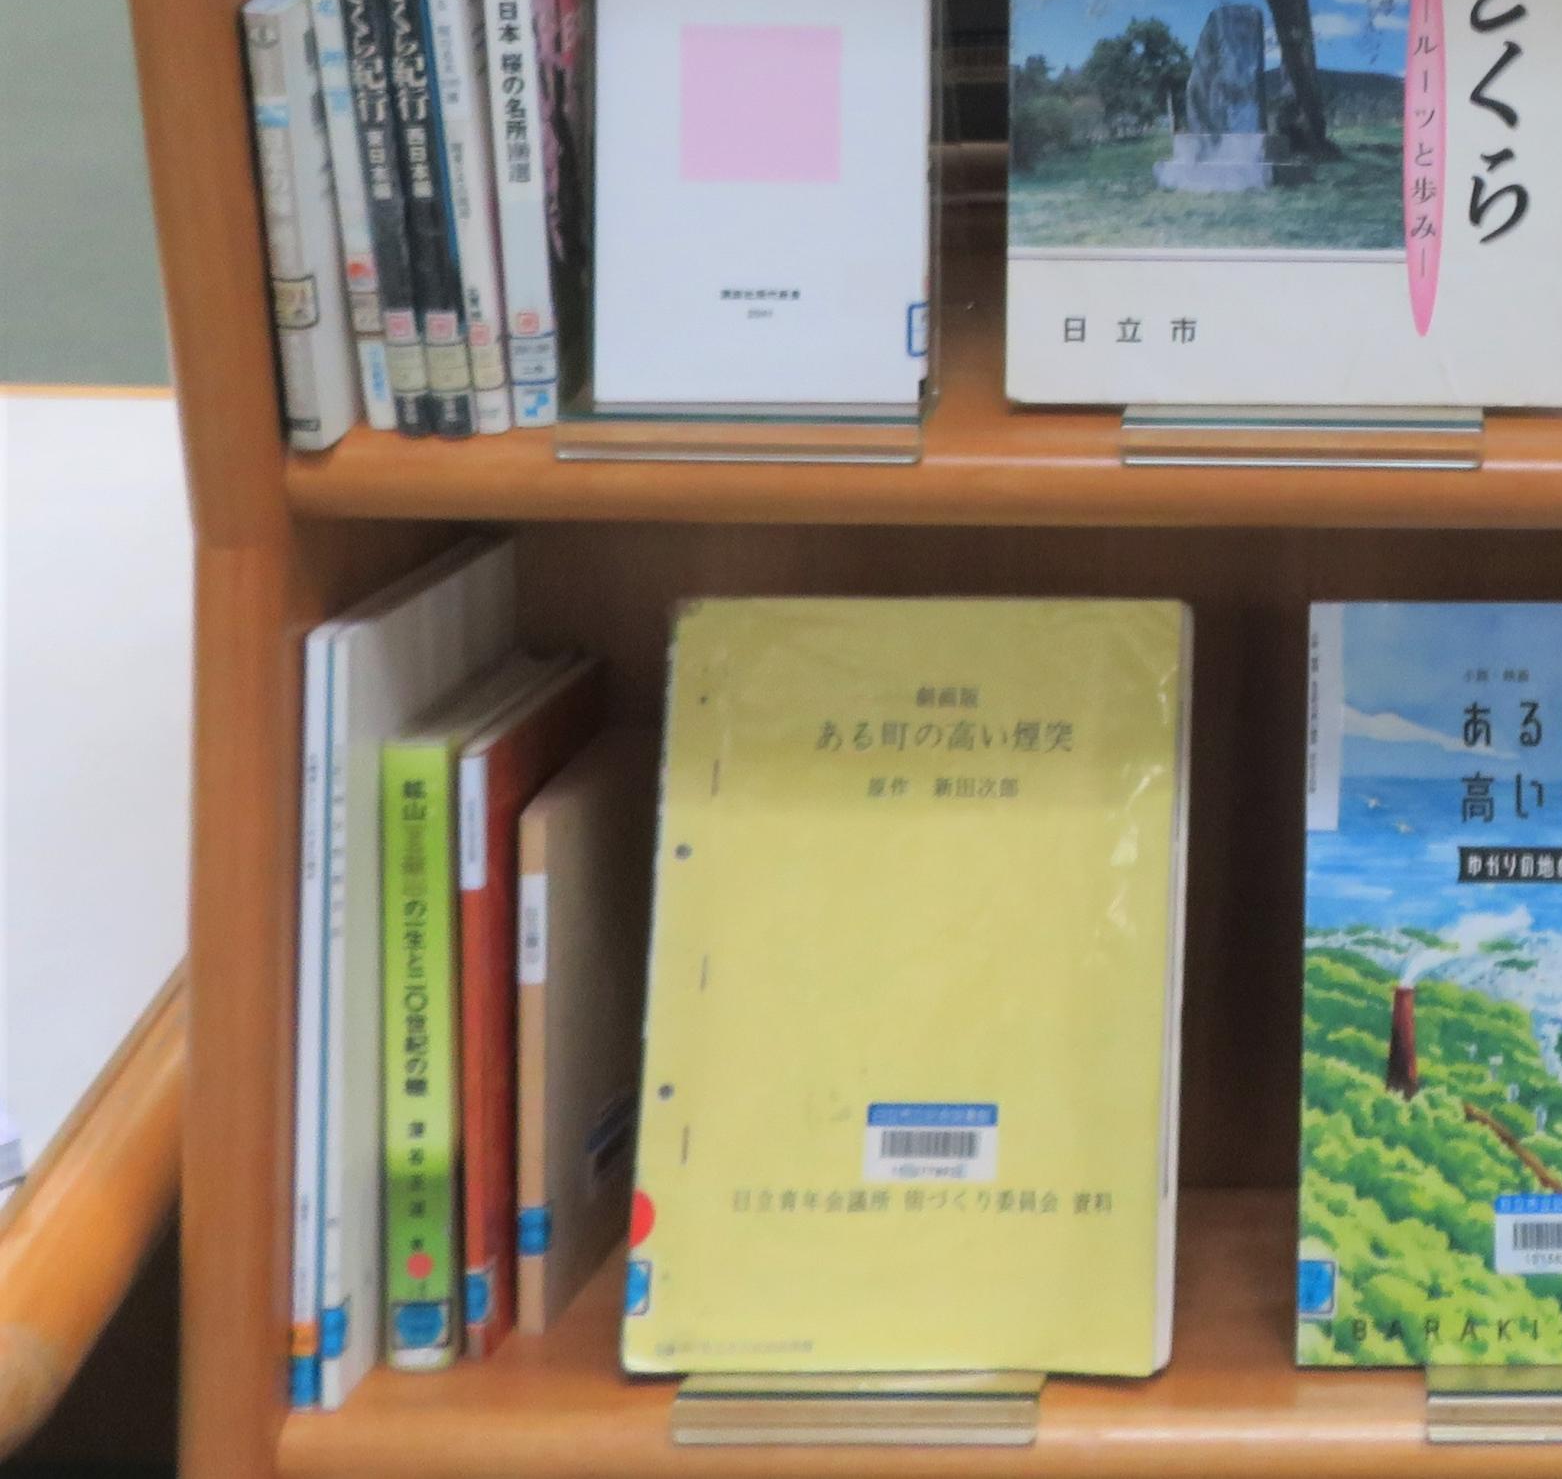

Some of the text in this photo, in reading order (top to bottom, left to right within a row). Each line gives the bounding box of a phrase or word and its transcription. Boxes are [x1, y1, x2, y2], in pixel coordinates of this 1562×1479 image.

[1062, 316, 1198, 345] 日立市
[814, 719, 1075, 754] ある町の高い煙突
[932, 775, 1020, 800] 新田次郎
